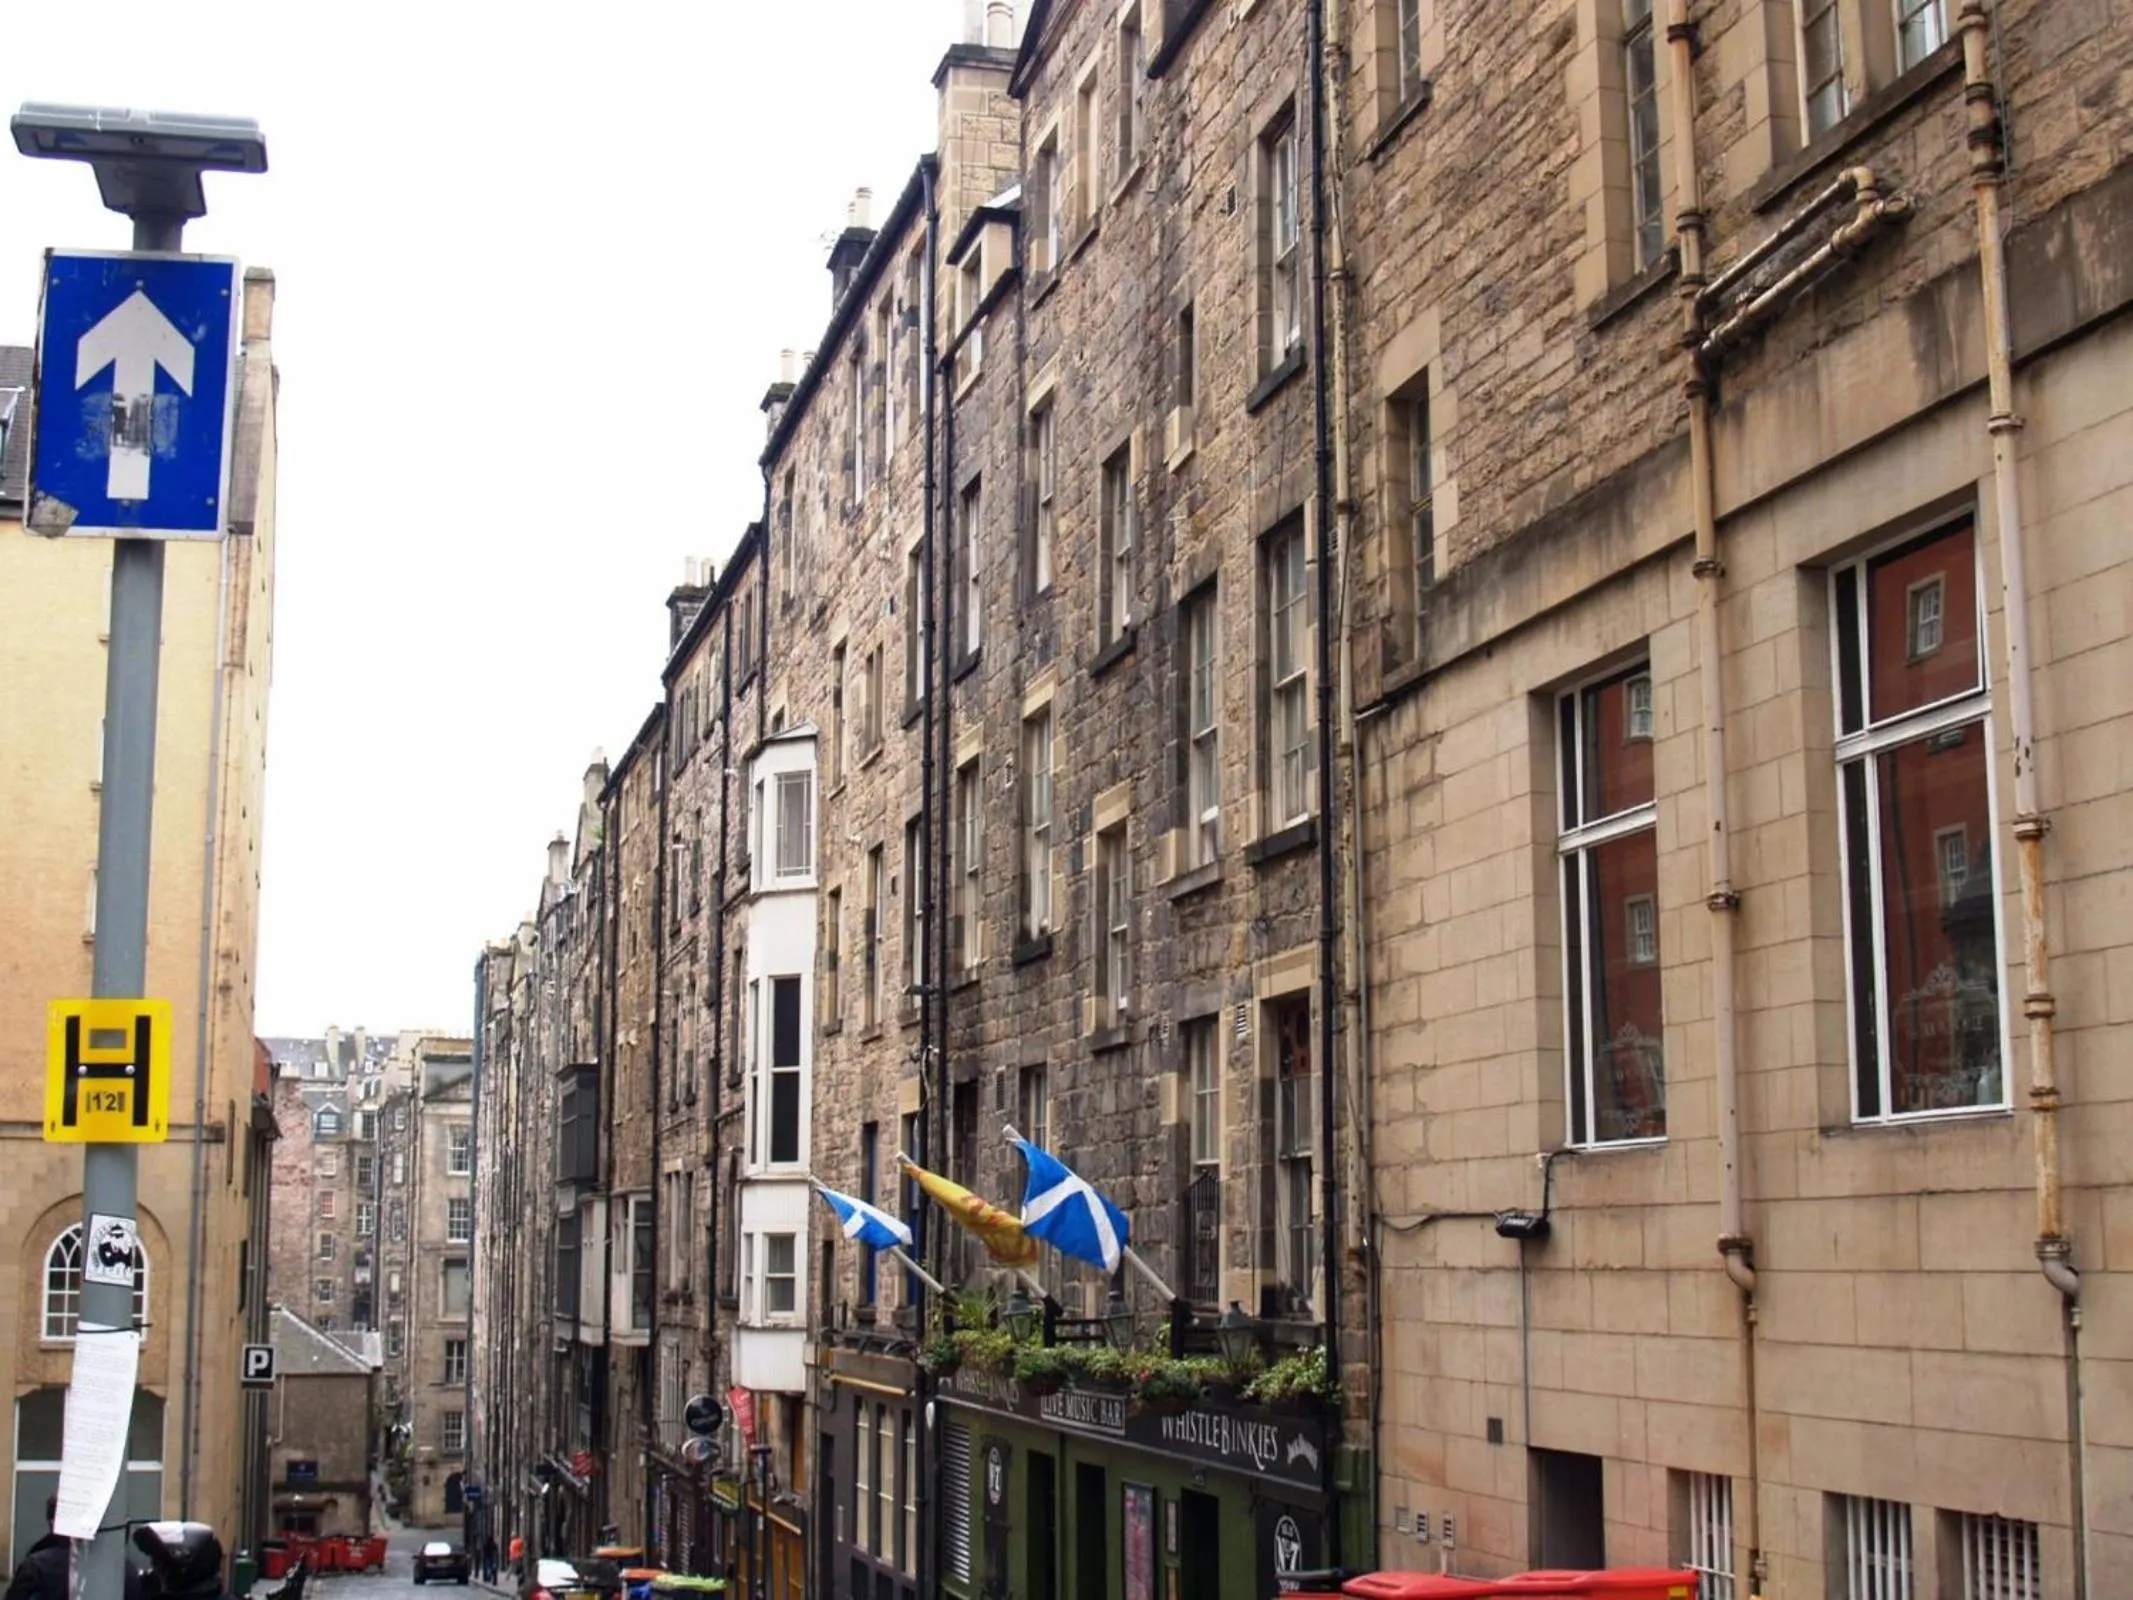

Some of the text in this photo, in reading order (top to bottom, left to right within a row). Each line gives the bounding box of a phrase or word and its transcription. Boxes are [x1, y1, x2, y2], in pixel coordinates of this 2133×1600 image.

[62, 1014, 151, 1126] H
[248, 1349, 270, 1377] P
[1043, 1393, 1122, 1427] LIVE MUSIC BAR
[1162, 1410, 1279, 1470] WHISTLEBINKIES
